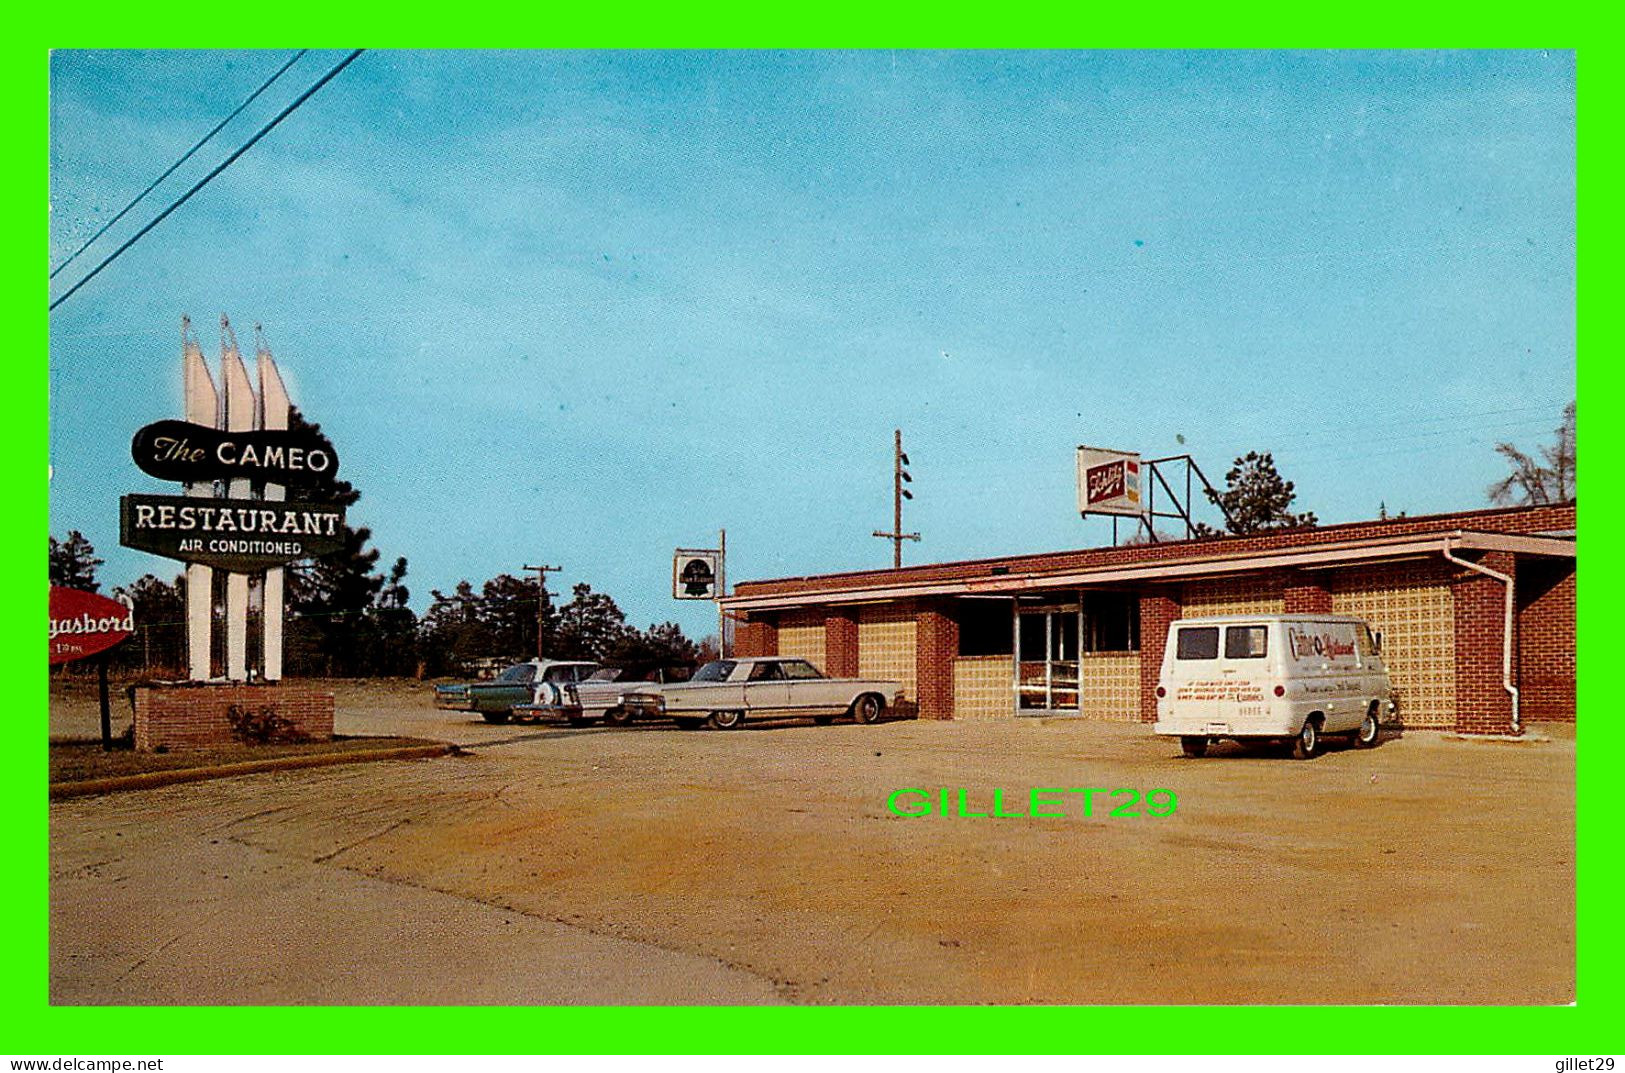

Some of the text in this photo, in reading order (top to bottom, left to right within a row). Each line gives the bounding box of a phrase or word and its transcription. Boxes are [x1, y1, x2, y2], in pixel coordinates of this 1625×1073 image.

[154, 437, 329, 472] The CAMEO
[135, 505, 339, 536] RESTAURANT
[179, 539, 302, 555] AIR CONDITIONED
